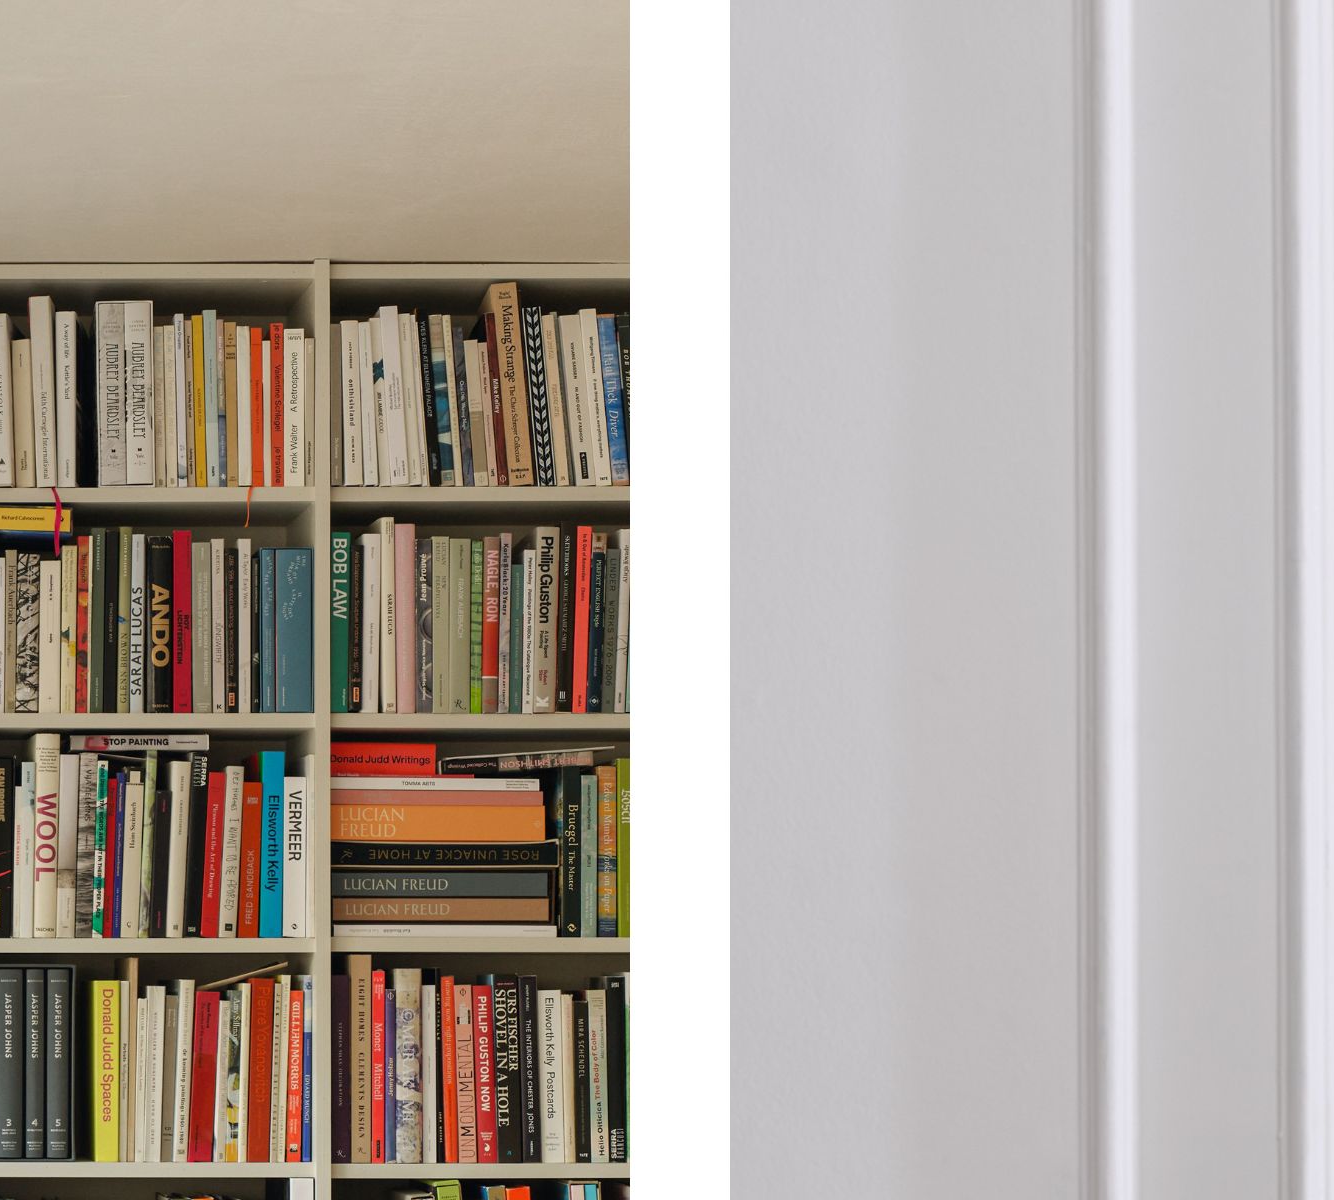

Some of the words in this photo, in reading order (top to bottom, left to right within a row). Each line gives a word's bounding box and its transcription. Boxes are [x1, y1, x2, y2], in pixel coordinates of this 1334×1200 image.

[500, 305, 513, 345] Making
[106, 343, 119, 381] AUBREY
[132, 342, 145, 380] AUBREY
[290, 352, 298, 404] Retrospective
[504, 345, 516, 383] Strange
[603, 352, 614, 376] Paul
[607, 380, 617, 404] Thek
[106, 385, 119, 440] BEARDSLEY
[132, 384, 146, 439] BEARDSLEY
[274, 400, 282, 431] Schlegel
[609, 409, 618, 437] Diver
[333, 538, 347, 573] BOB
[487, 550, 499, 592] NAGLE,
[538, 536, 553, 572] Philip
[8, 565, 16, 587] Frank
[8, 589, 16, 625] Auerbach
[132, 588, 142, 636] LUCAS
[333, 579, 347, 619] LAW
[487, 597, 498, 622] RON
[539, 574, 552, 623] Guston
[151, 584, 169, 668] ANDO
[131, 644, 141, 696] SARAH
[104, 738, 126, 746] STOP
[331, 755, 363, 765] Donald
[365, 755, 389, 764] Judd
[391, 755, 430, 766] Writings
[340, 807, 404, 822] LUCIAN
[603, 783, 612, 812] Edvard
[36, 793, 58, 882] WOOL
[268, 795, 279, 856] Ellsworth
[288, 790, 302, 861] VERMEER
[340, 824, 396, 837] FREUD
[565, 804, 578, 846] Bruegel
[603, 814, 612, 844] Munch
[368, 849, 410, 859] HOME
[415, 850, 430, 859] AT
[437, 850, 497, 859] UNIACKE
[503, 850, 539, 861] ROSE
[603, 848, 612, 874] Works
[265, 860, 279, 892] Kelly
[344, 879, 397, 891] LUCIAN
[403, 879, 448, 891] FREUD
[604, 876, 610, 886] on
[345, 904, 399, 916] LUCIAN
[404, 904, 450, 915] FREUD
[602, 888, 612, 912] Paper
[102, 989, 113, 1035] Donald
[478, 996, 488, 1033] PHILIP
[495, 989, 506, 1047] SHOVEL
[508, 989, 516, 1013] URS
[545, 998, 554, 1041] Ellsworth
[102, 1037, 113, 1071] Judd
[374, 1023, 382, 1052] Monet
[508, 1017, 518, 1071] FISCHER
[544, 1044, 554, 1066] Kelly
[480, 1036, 489, 1082] GUSTON
[497, 1052, 507, 1068] IN
[374, 1063, 382, 1100] Mitchell
[498, 1072, 508, 1083] A
[101, 1074, 113, 1122] Spaces
[458, 1035, 475, 1159] UNMONUMENTAL
[481, 1086, 490, 1112] NOW
[498, 1087, 508, 1127] HOLE
[547, 1072, 555, 1119] Postcards
